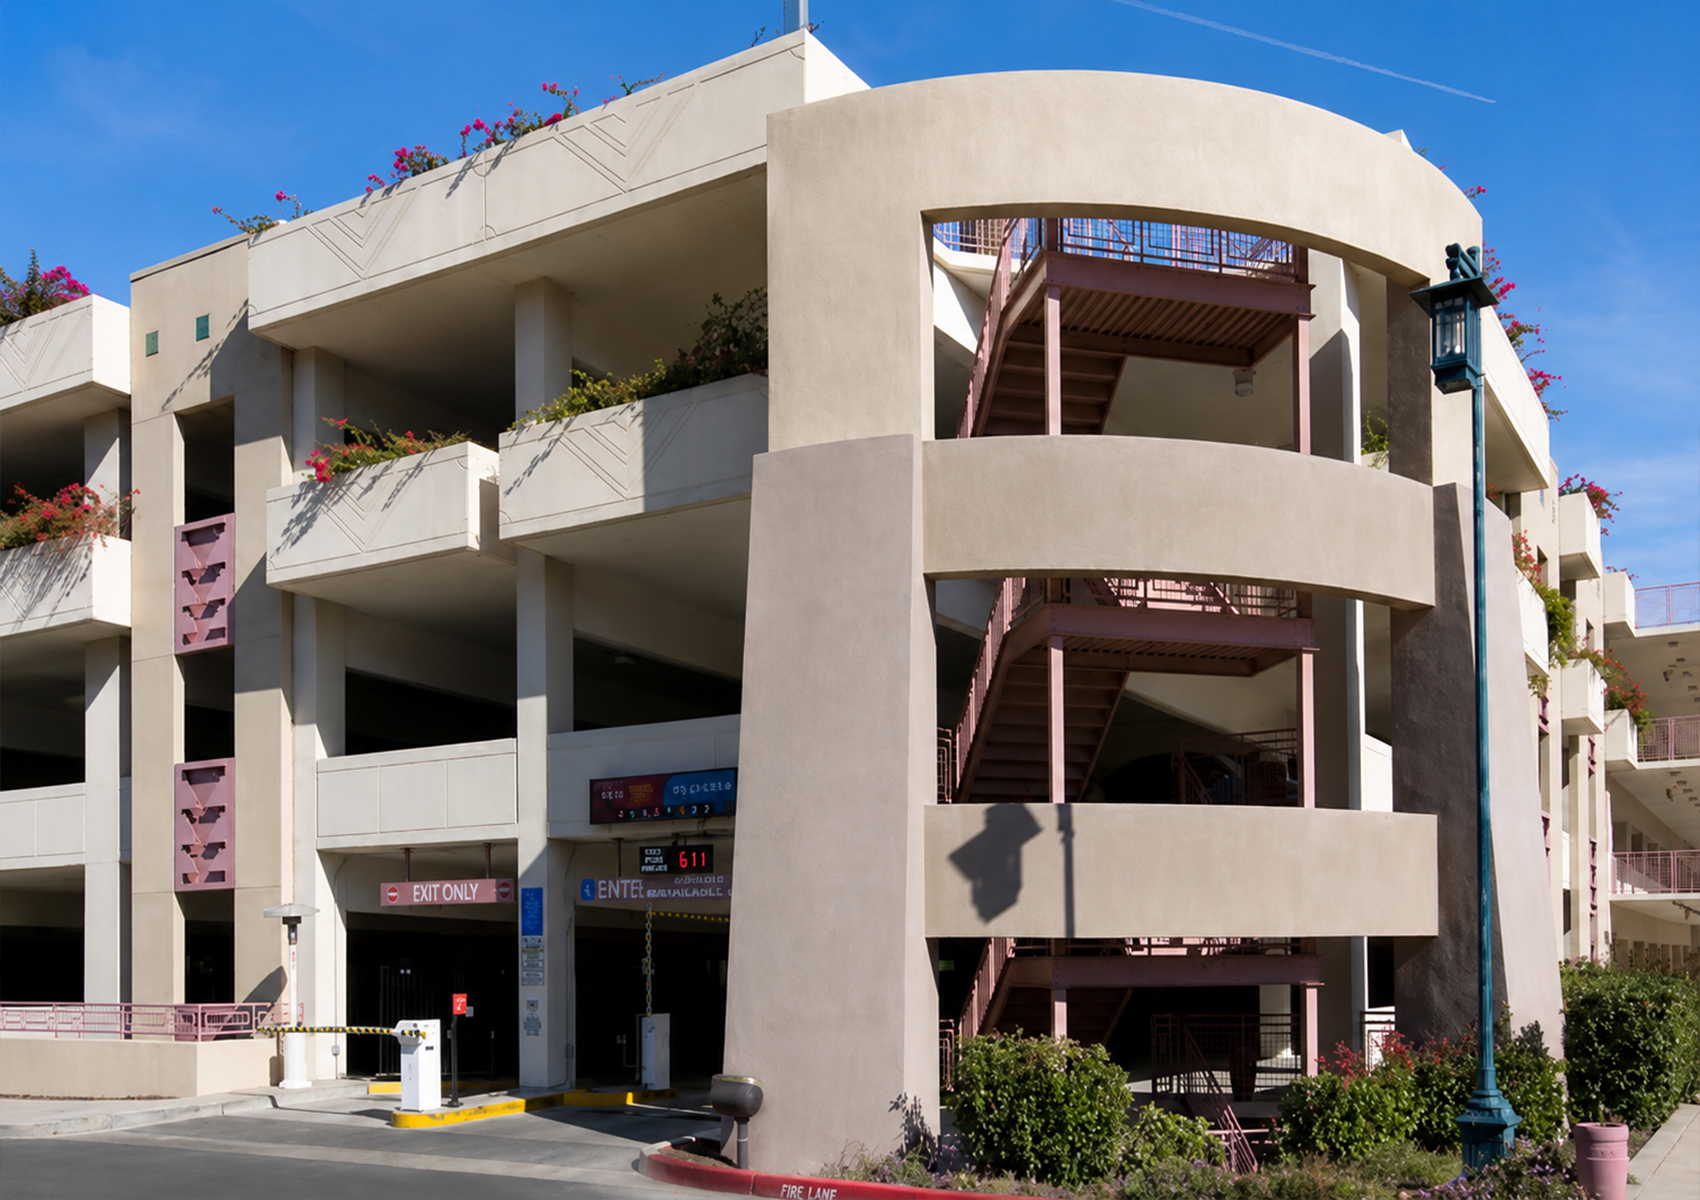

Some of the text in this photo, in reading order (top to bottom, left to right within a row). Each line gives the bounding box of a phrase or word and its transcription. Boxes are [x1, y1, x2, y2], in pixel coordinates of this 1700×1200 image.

[679, 851, 706, 868] 611
[413, 883, 479, 902] EXIT ONLY
[780, 1183, 805, 1200] FIRE
